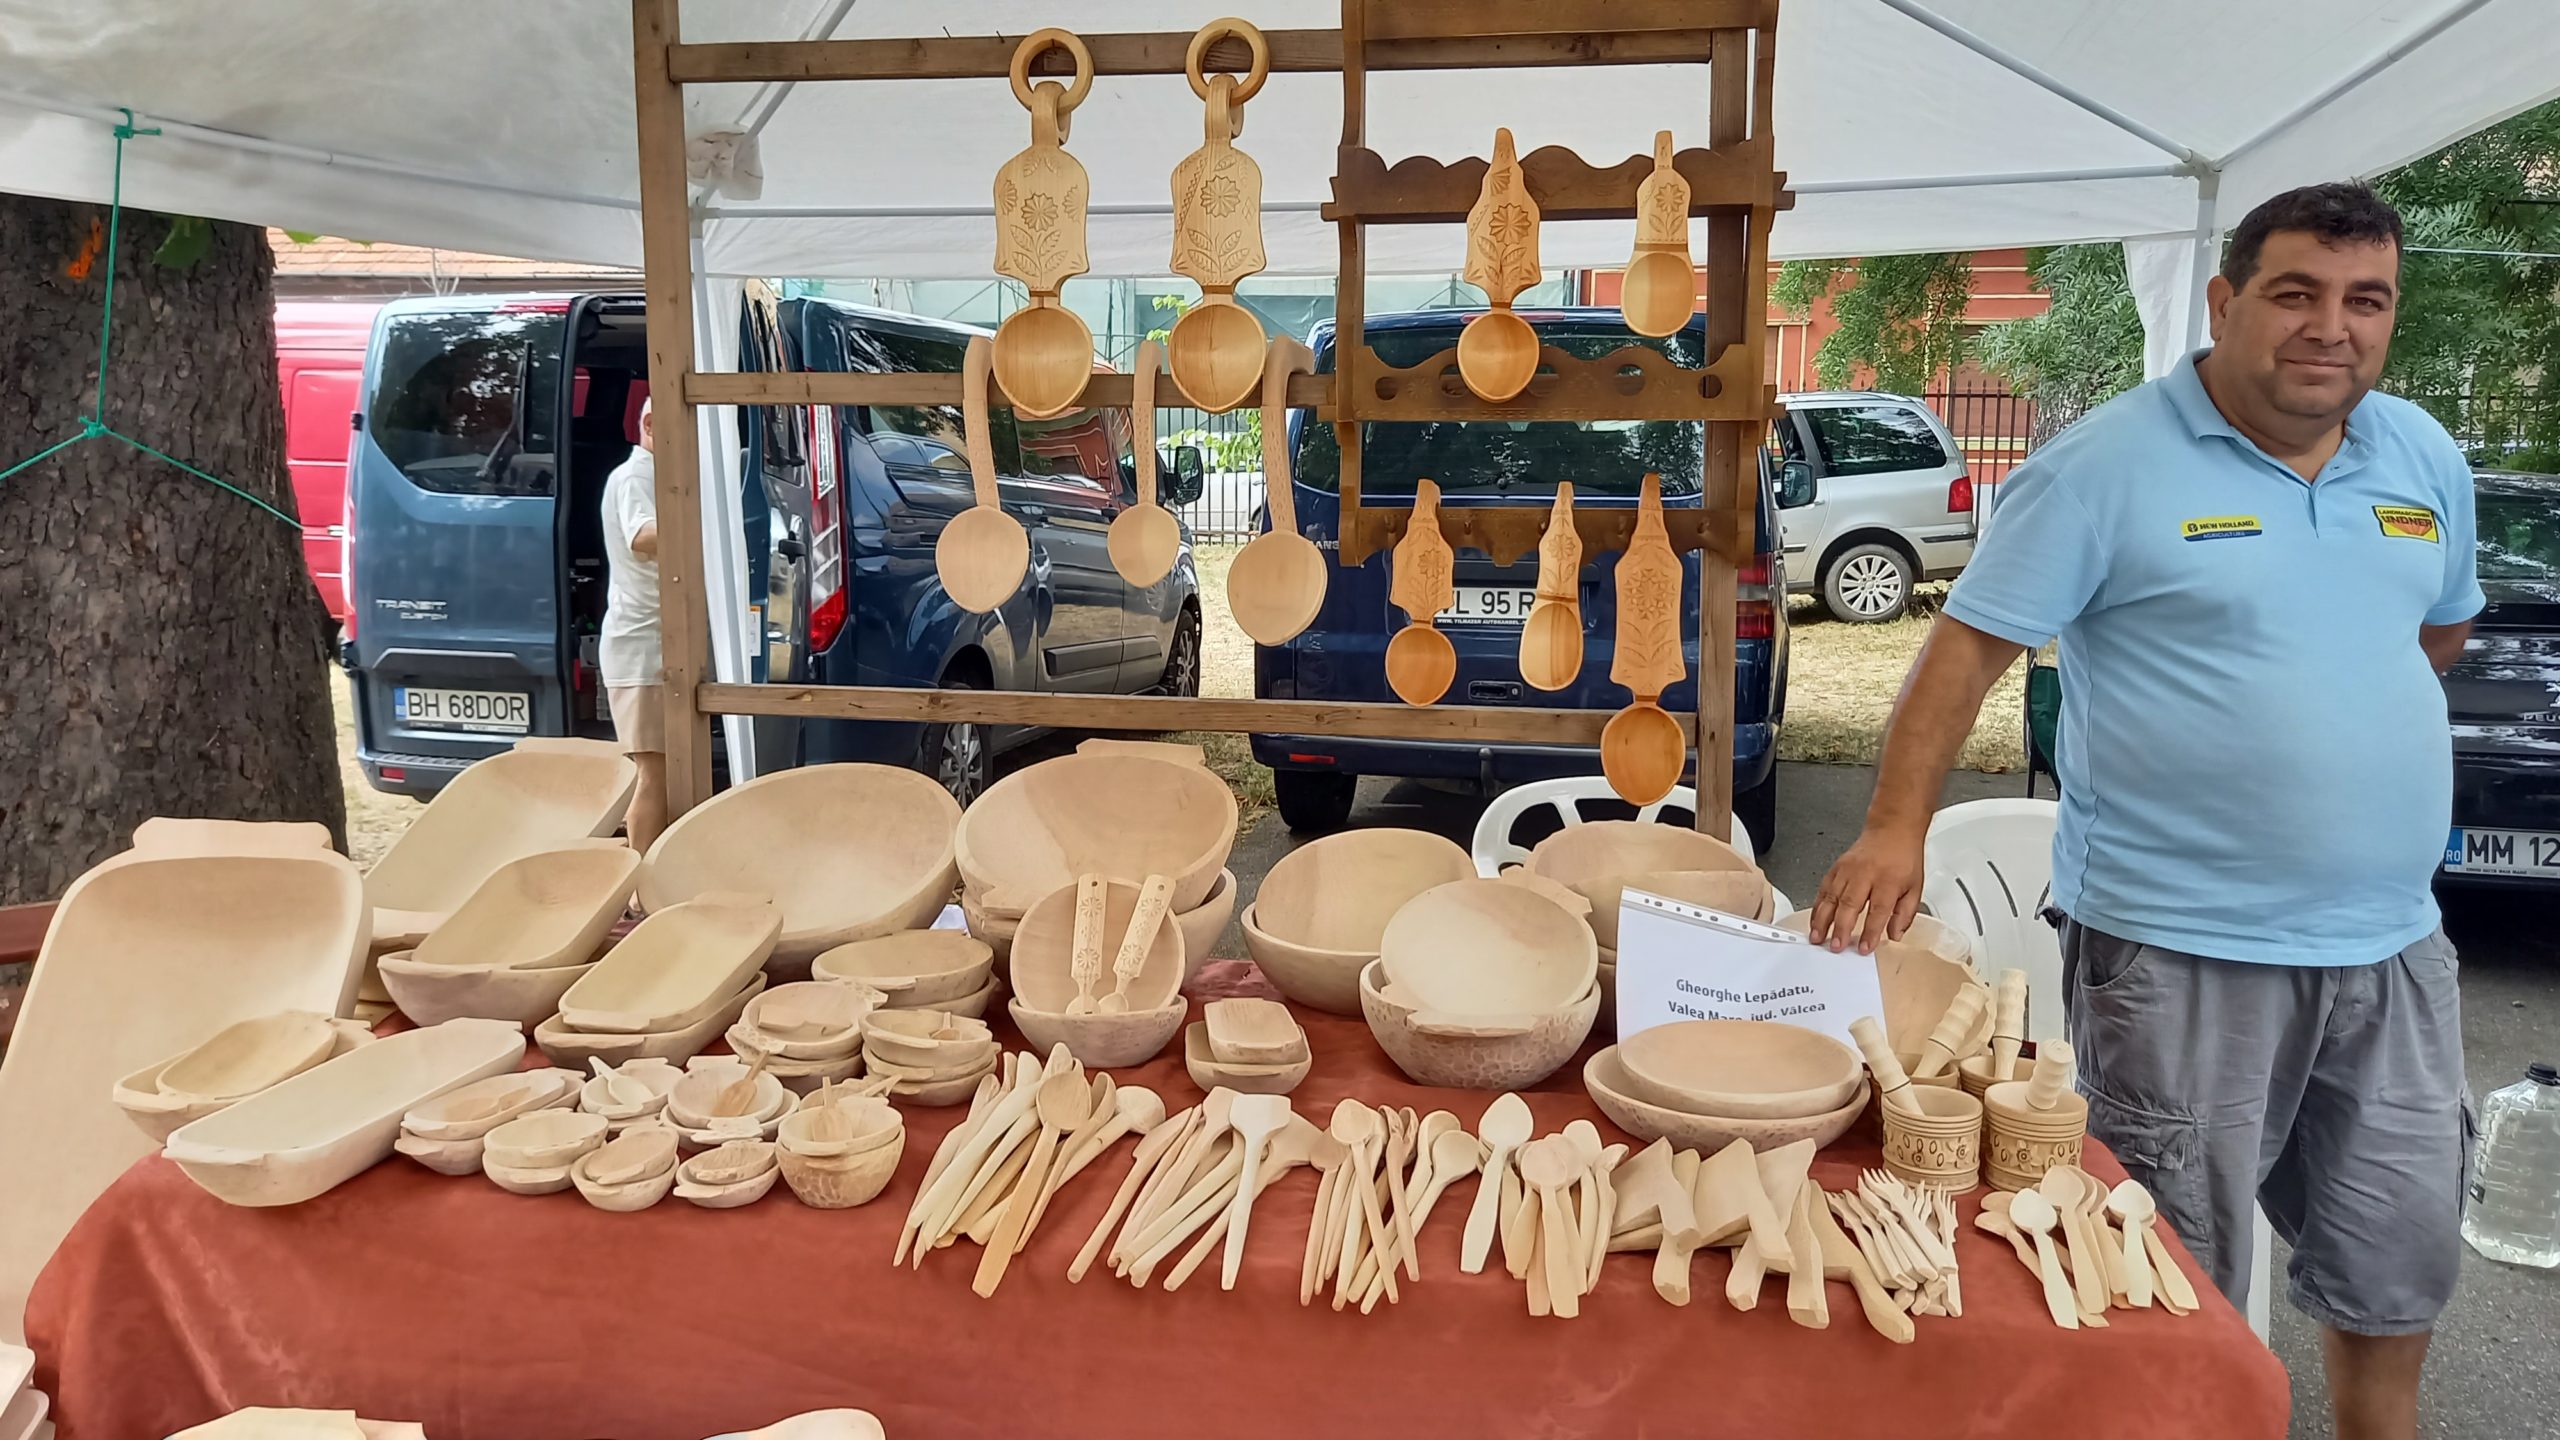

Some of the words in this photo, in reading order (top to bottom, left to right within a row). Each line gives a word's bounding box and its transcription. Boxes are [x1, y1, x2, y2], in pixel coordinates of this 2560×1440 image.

[2200, 522, 2218, 530] NEW
[2218, 520, 2254, 529] HOLLAND
[376, 599, 448, 611] TRANSIT
[1481, 591, 1511, 614] 95
[408, 692, 440, 717] BH
[2522, 712, 2560, 722] PEU
[2446, 849, 2461, 862] RO
[2467, 834, 2514, 865] MM
[2529, 837, 2560, 867] 12
[1676, 979, 1741, 1003] Gheorghe
[1668, 1000, 1705, 1020] Valea
